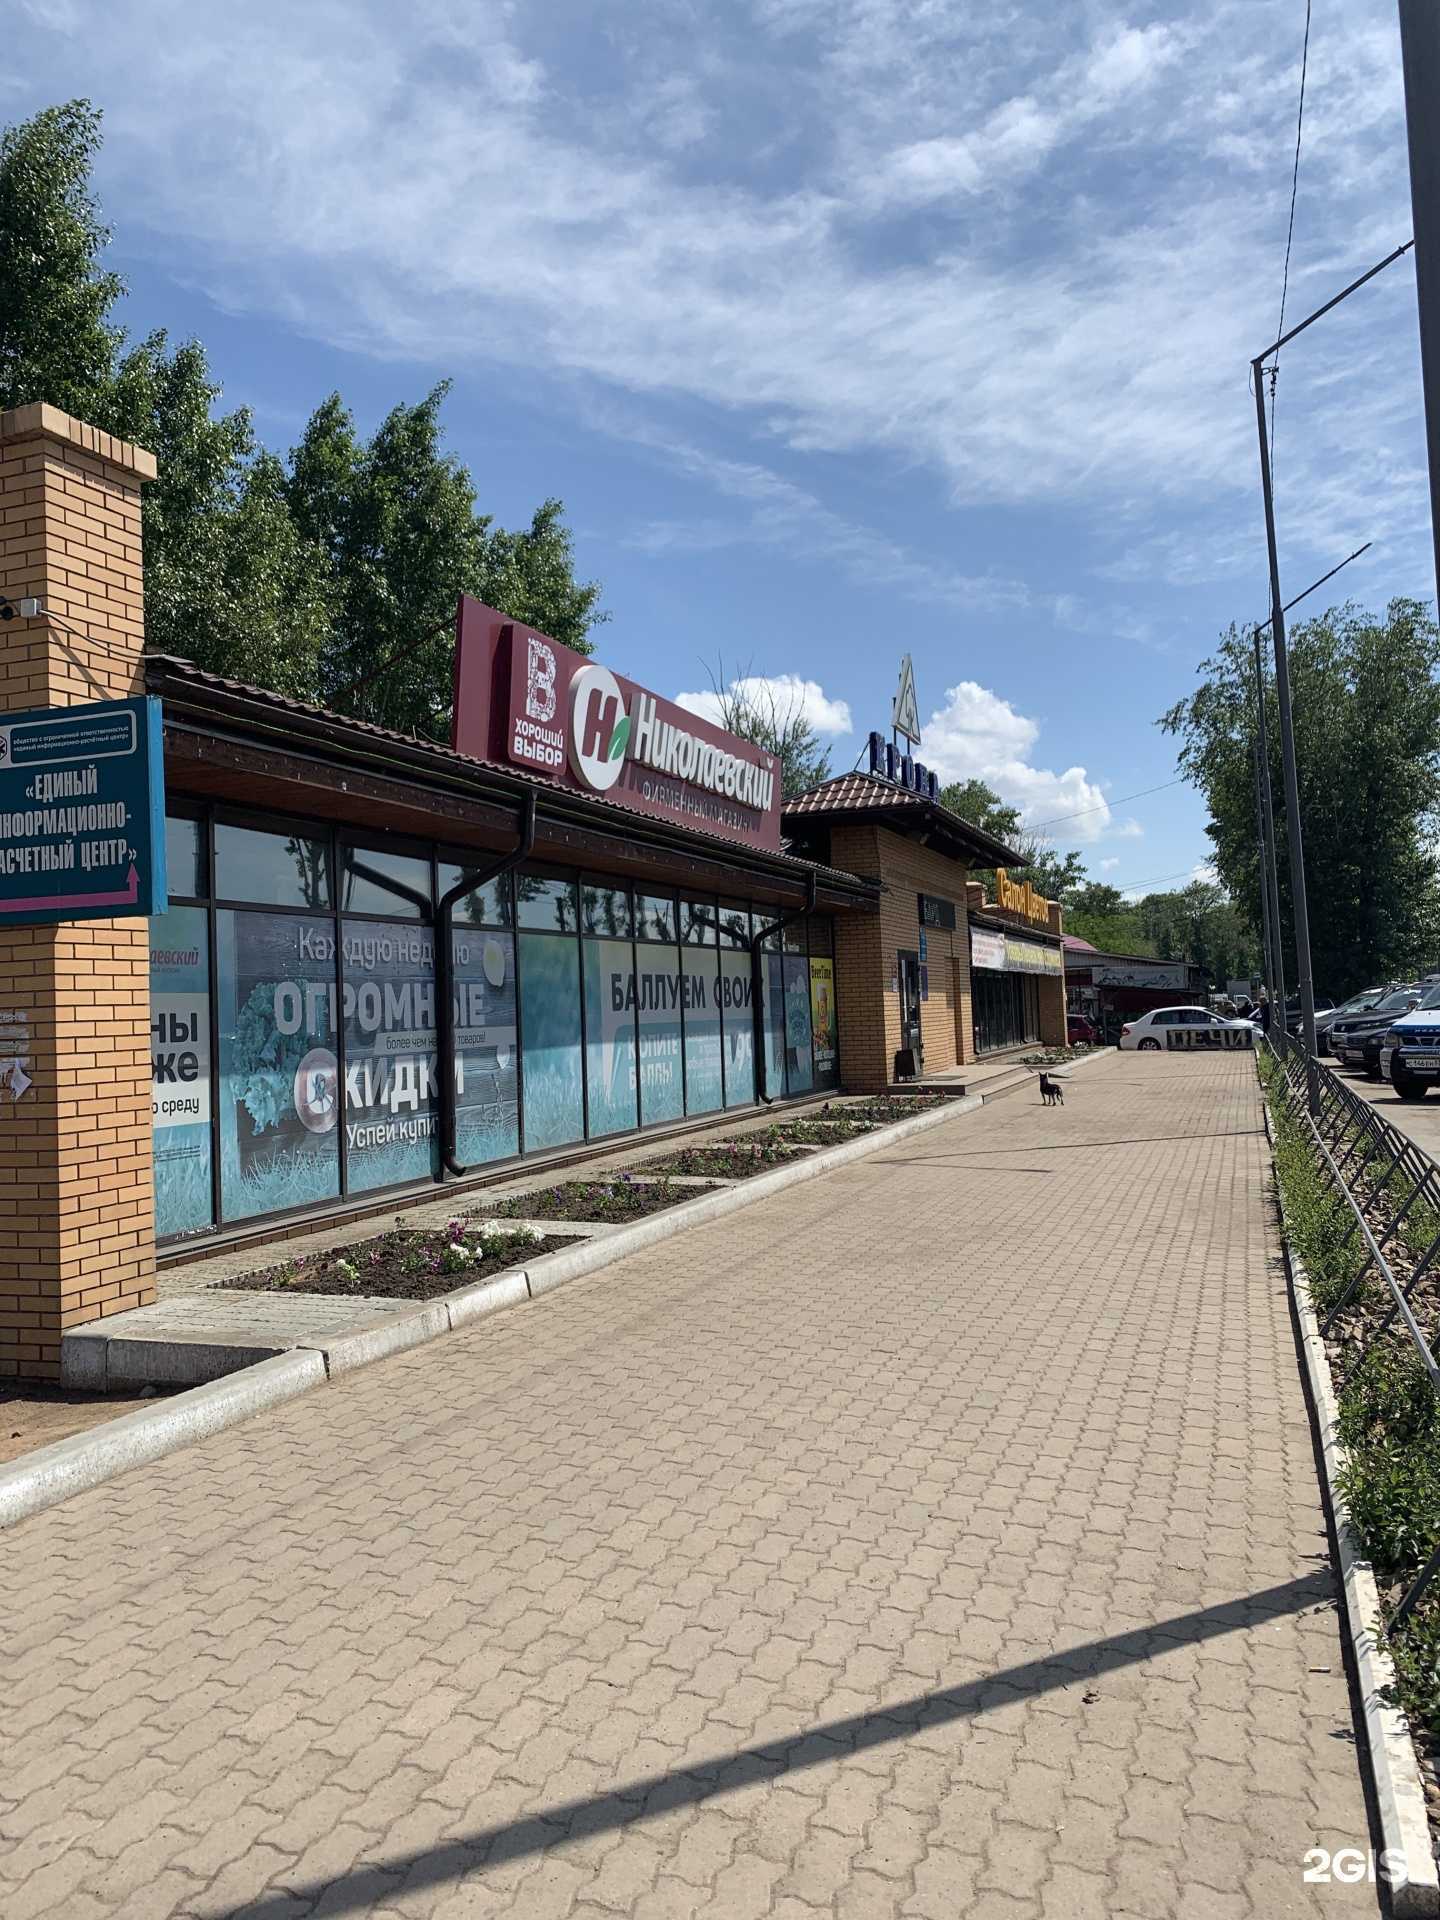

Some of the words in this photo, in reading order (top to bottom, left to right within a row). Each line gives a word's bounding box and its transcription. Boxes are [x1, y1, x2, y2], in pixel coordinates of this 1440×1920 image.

[513, 735, 563, 767] ВЫБОР
[631, 692, 774, 812] Николаевский
[25, 764, 98, 803] «ЕДИНЫЙ
[0, 801, 132, 839] НФОРМАЦИОННО-
[81, 838, 137, 871] ЦЕНТР»
[399, 941, 470, 968] недю
[611, 972, 706, 1011] БАЛЛУЕМ
[713, 976, 766, 1009] СВОИ
[1168, 1030, 1248, 1048] ПЕЧИ
[161, 1097, 200, 1117] среду
[346, 1117, 396, 1149] Успей
